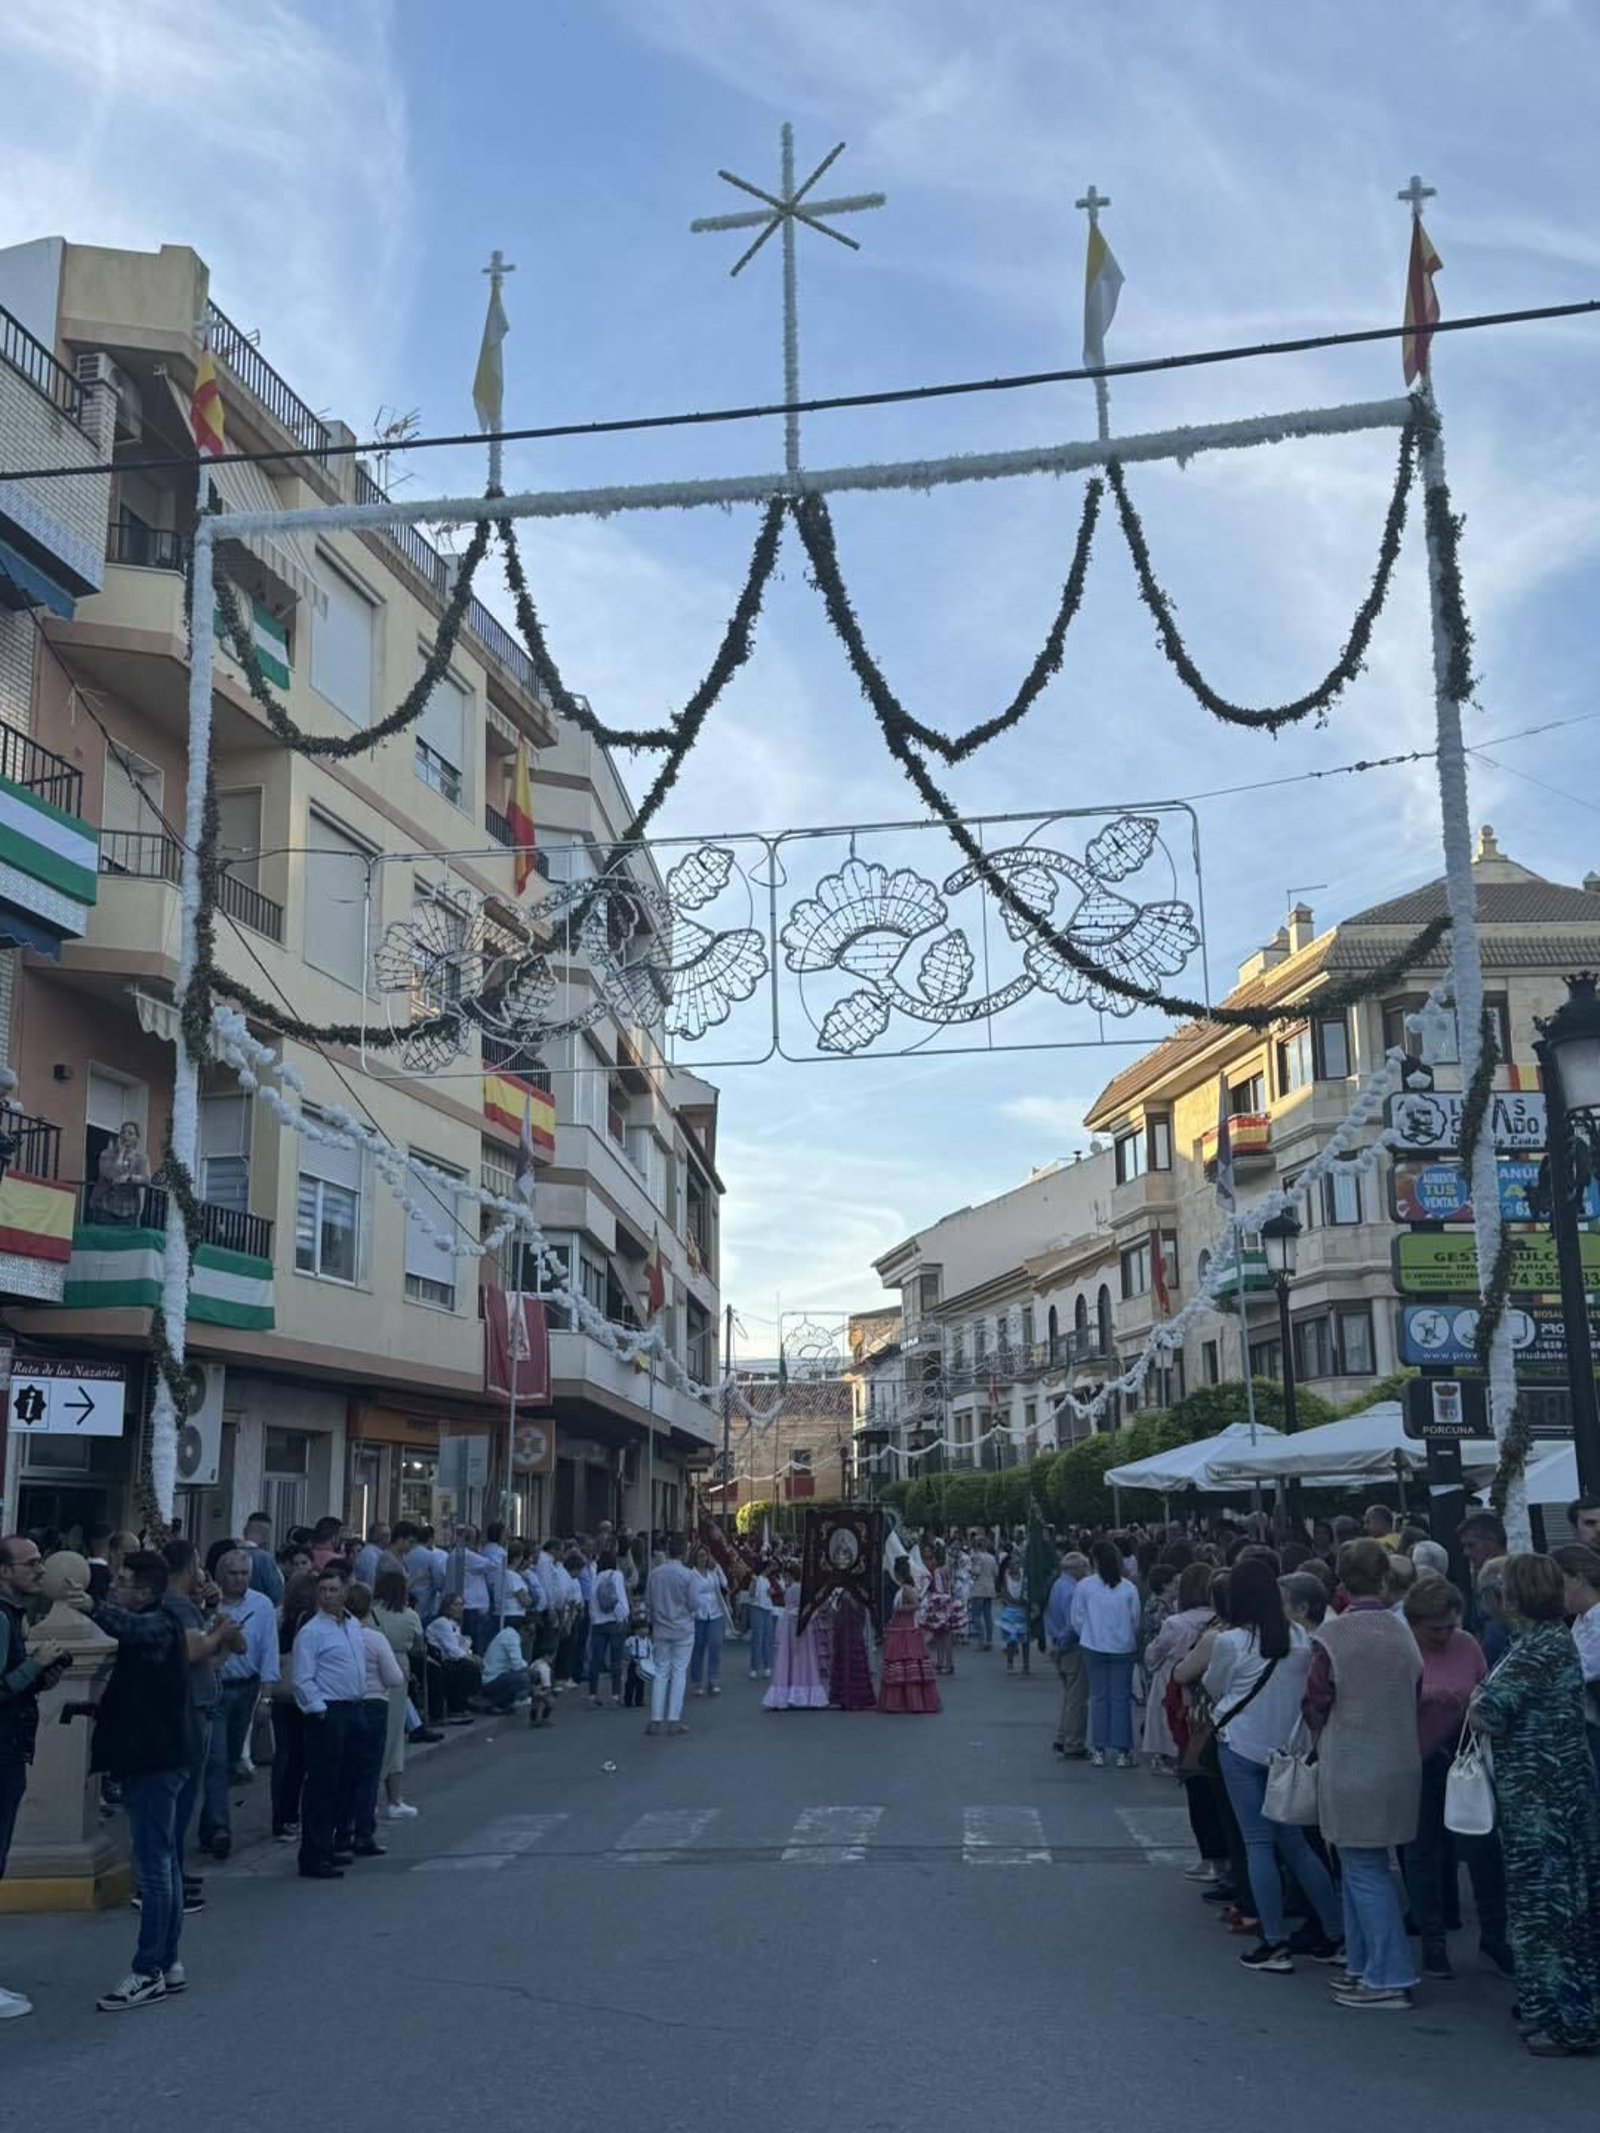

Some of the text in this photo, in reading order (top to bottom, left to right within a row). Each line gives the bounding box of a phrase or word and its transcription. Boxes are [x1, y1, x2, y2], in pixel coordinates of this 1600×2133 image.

[1425, 1184, 1457, 1195] TUS
[1423, 1196, 1460, 1208] VENTAS
[12, 1361, 39, 1374] Ruta
[42, 1363, 54, 1375] de
[56, 1363, 71, 1375] los
[1422, 1425, 1475, 1435] PORCUNA
